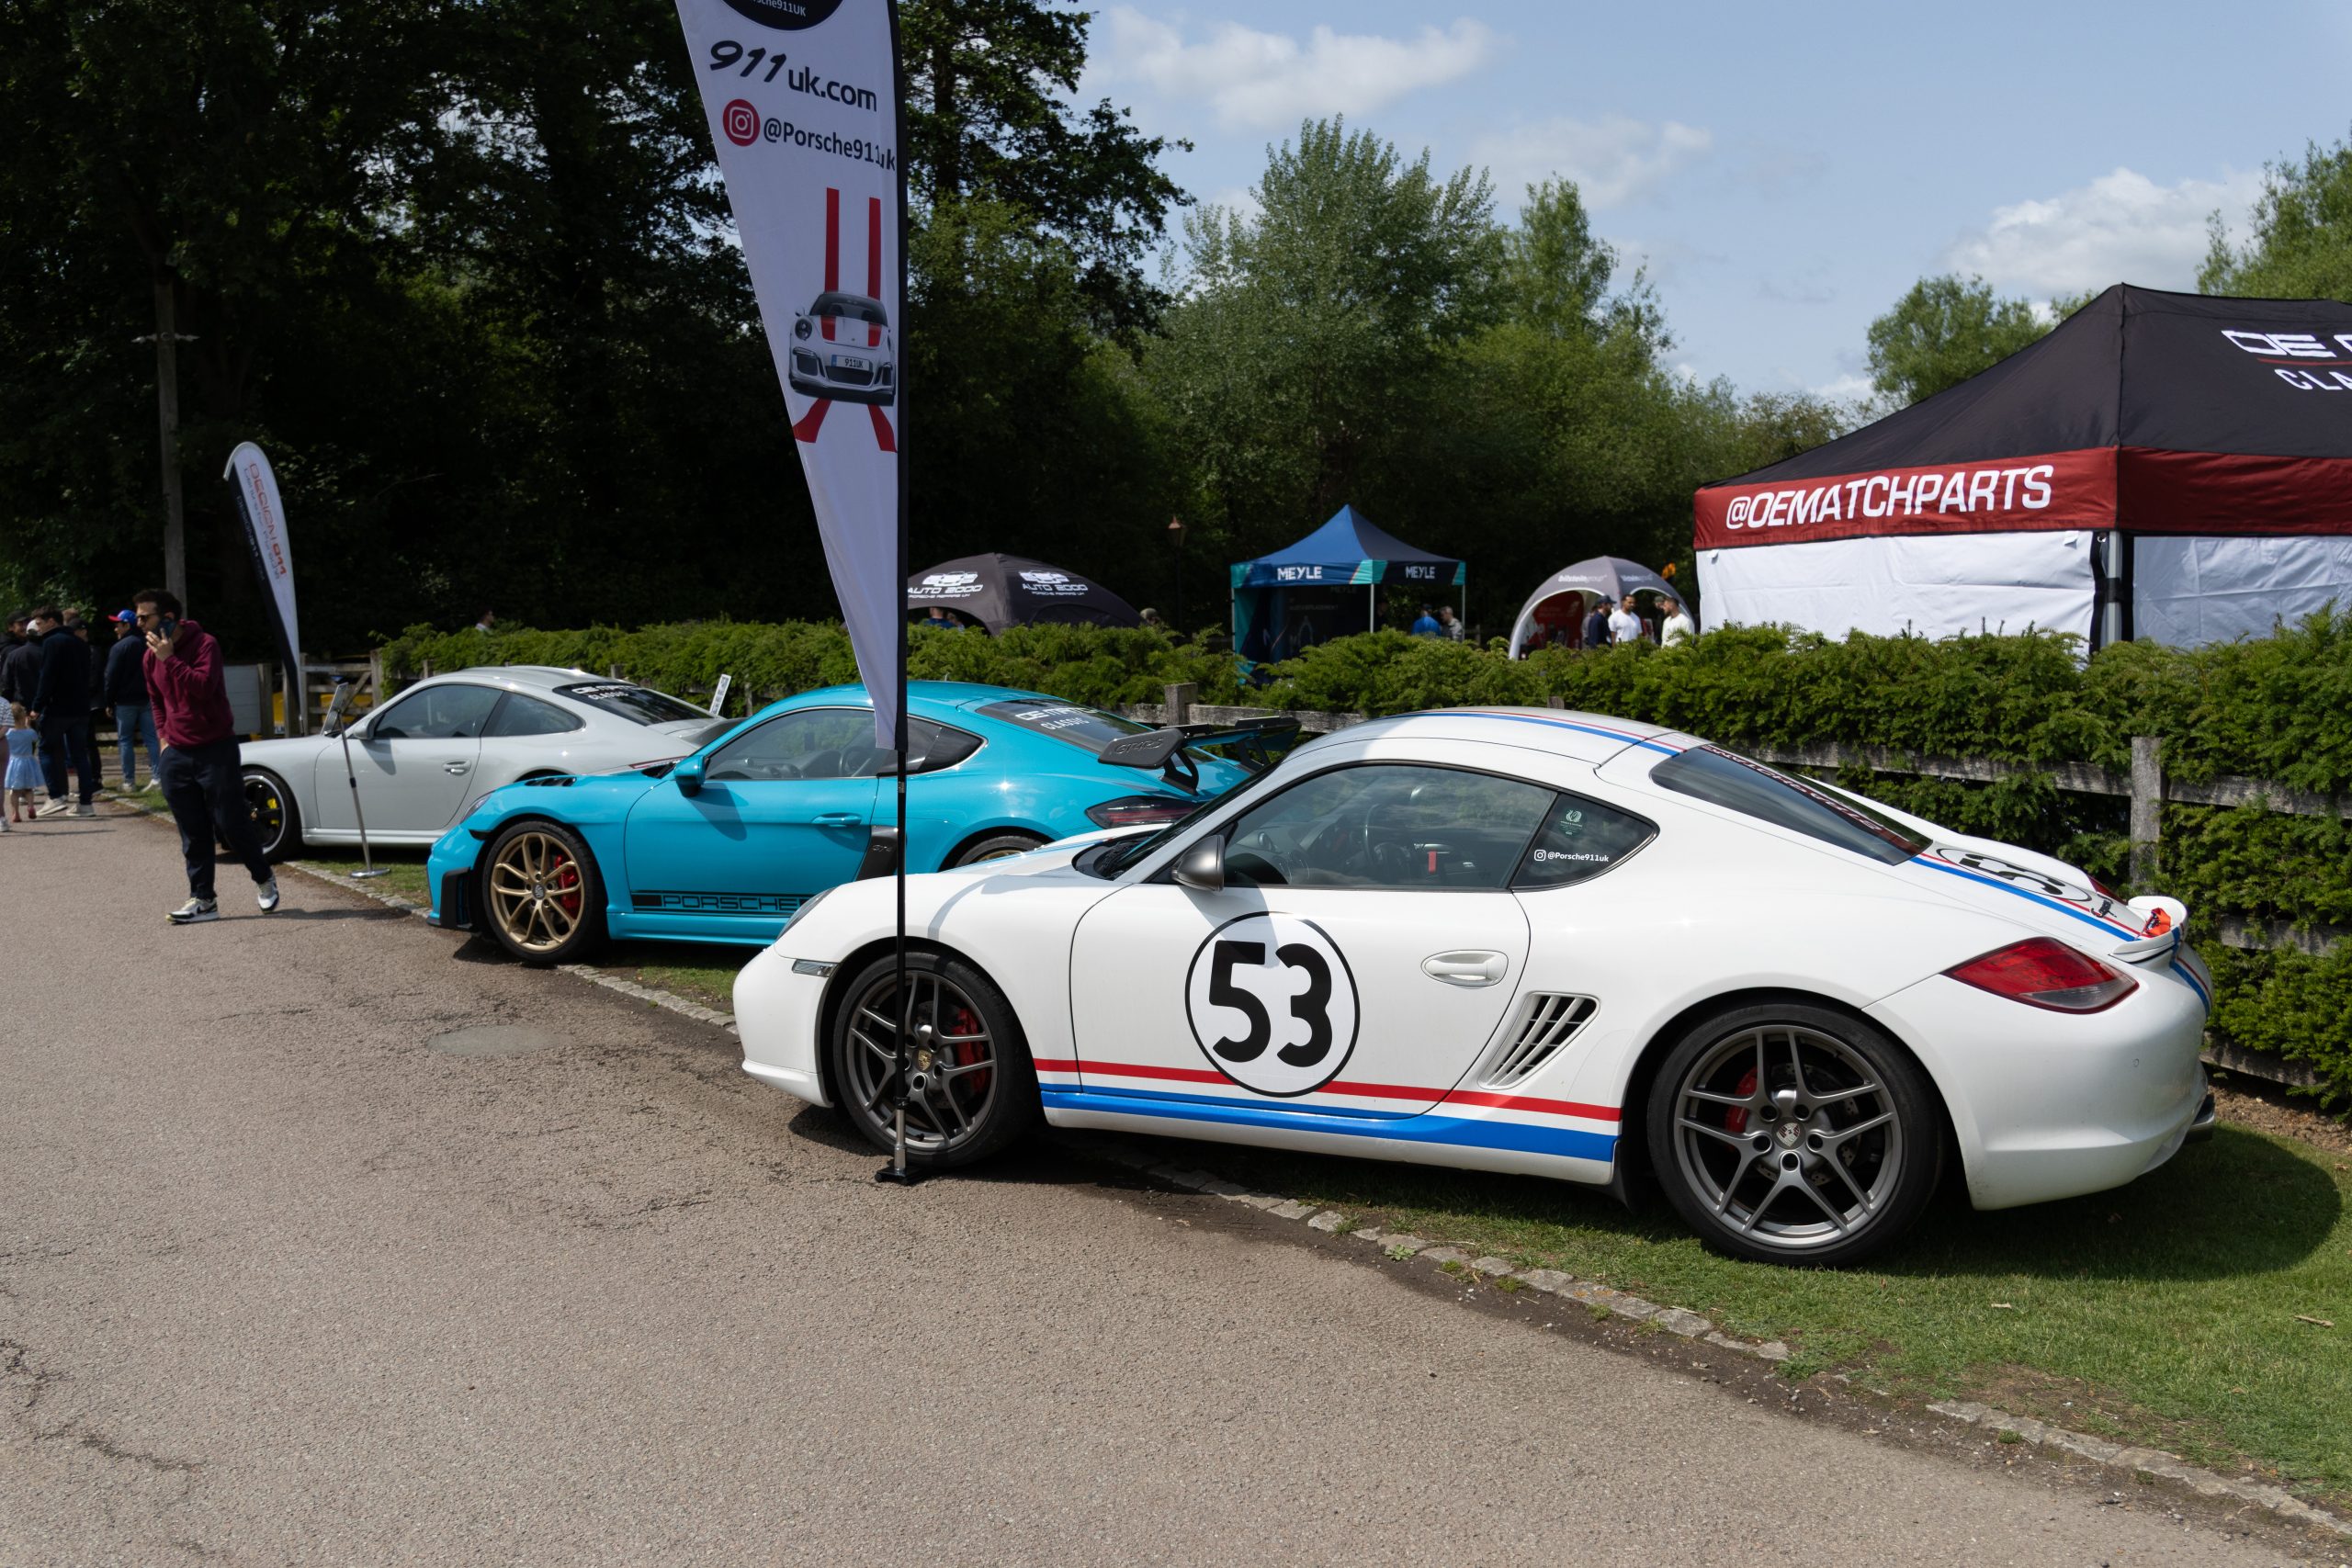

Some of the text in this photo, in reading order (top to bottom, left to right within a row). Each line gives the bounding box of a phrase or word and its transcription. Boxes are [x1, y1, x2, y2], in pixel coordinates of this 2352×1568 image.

[763, 118, 896, 172] @Porsche911uk
[1726, 465, 2054, 530] @OEMATCHPARTS
[1277, 566, 1323, 581] MEYLE
[1405, 566, 1435, 579] MEYLE
[908, 584, 984, 594] AUTO 2000
[1023, 583, 1051, 592] AUTO
[1547, 851, 1610, 863] @Porsche911uk
[662, 895, 799, 911] PORSCHE
[1208, 939, 1333, 1068] 53
